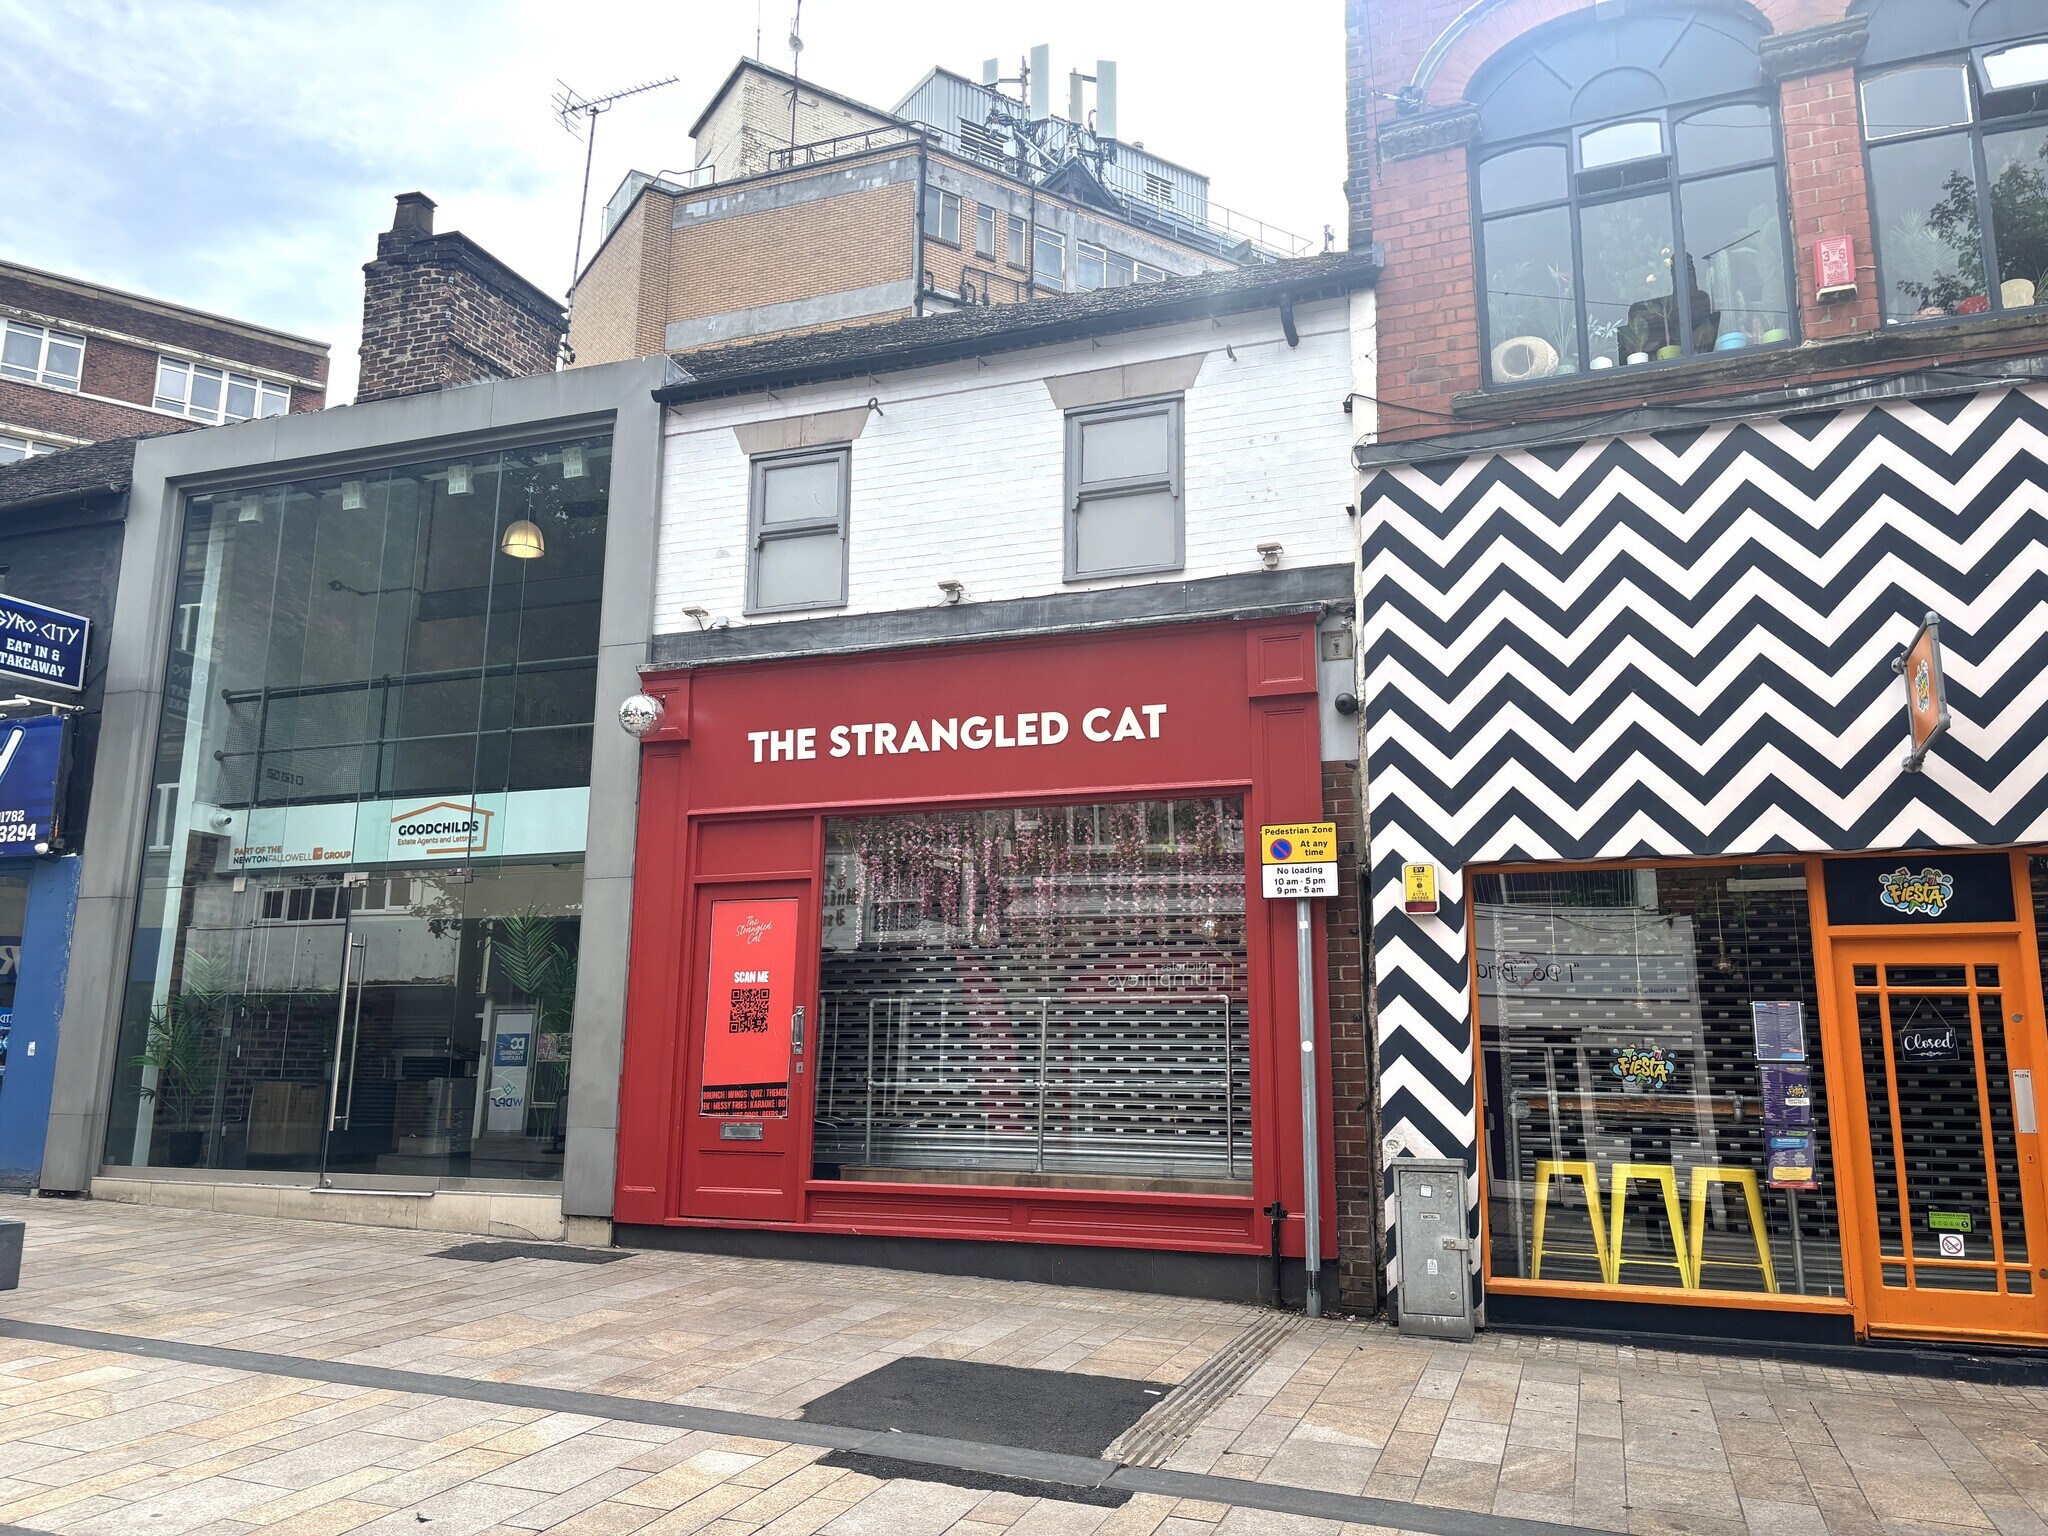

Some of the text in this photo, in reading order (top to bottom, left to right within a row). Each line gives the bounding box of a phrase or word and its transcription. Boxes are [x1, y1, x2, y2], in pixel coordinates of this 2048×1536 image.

[6, 637, 60, 662] EAT IN &
[0, 651, 65, 678] TAKEAWAY
[747, 703, 1168, 763] THE STRANGLED CAT
[0, 809, 25, 823] 1782
[398, 820, 479, 836] GOODCHILDS
[1264, 826, 1333, 836] Pedestrian Zone
[398, 838, 417, 846] Estate
[417, 836, 439, 847] Agents
[440, 835, 451, 843] and
[1300, 840, 1310, 848] At
[234, 845, 283, 856] PART OF THE
[323, 850, 352, 860] GROUP
[1276, 866, 1323, 875] No loading
[1274, 877, 1284, 886] 10
[1305, 876, 1311, 885] 5
[1312, 877, 1326, 886] pm
[1276, 886, 1283, 894] 9
[1284, 887, 1297, 895] pm
[1303, 886, 1309, 894] 5
[746, 915, 760, 927] The
[735, 920, 773, 937] Strangled
[747, 931, 763, 944] Cat
[734, 970, 769, 983] SCAN ME
[1903, 1031, 1955, 1051] Closed
[703, 1091, 726, 1100] BRUNCH
[727, 1089, 748, 1099] WINGS
[750, 1088, 763, 1099] QUIZ
[713, 1101, 731, 1110] MESSY
[732, 1100, 748, 1109] FRIES
[749, 1099, 776, 1109] KARAOKE
